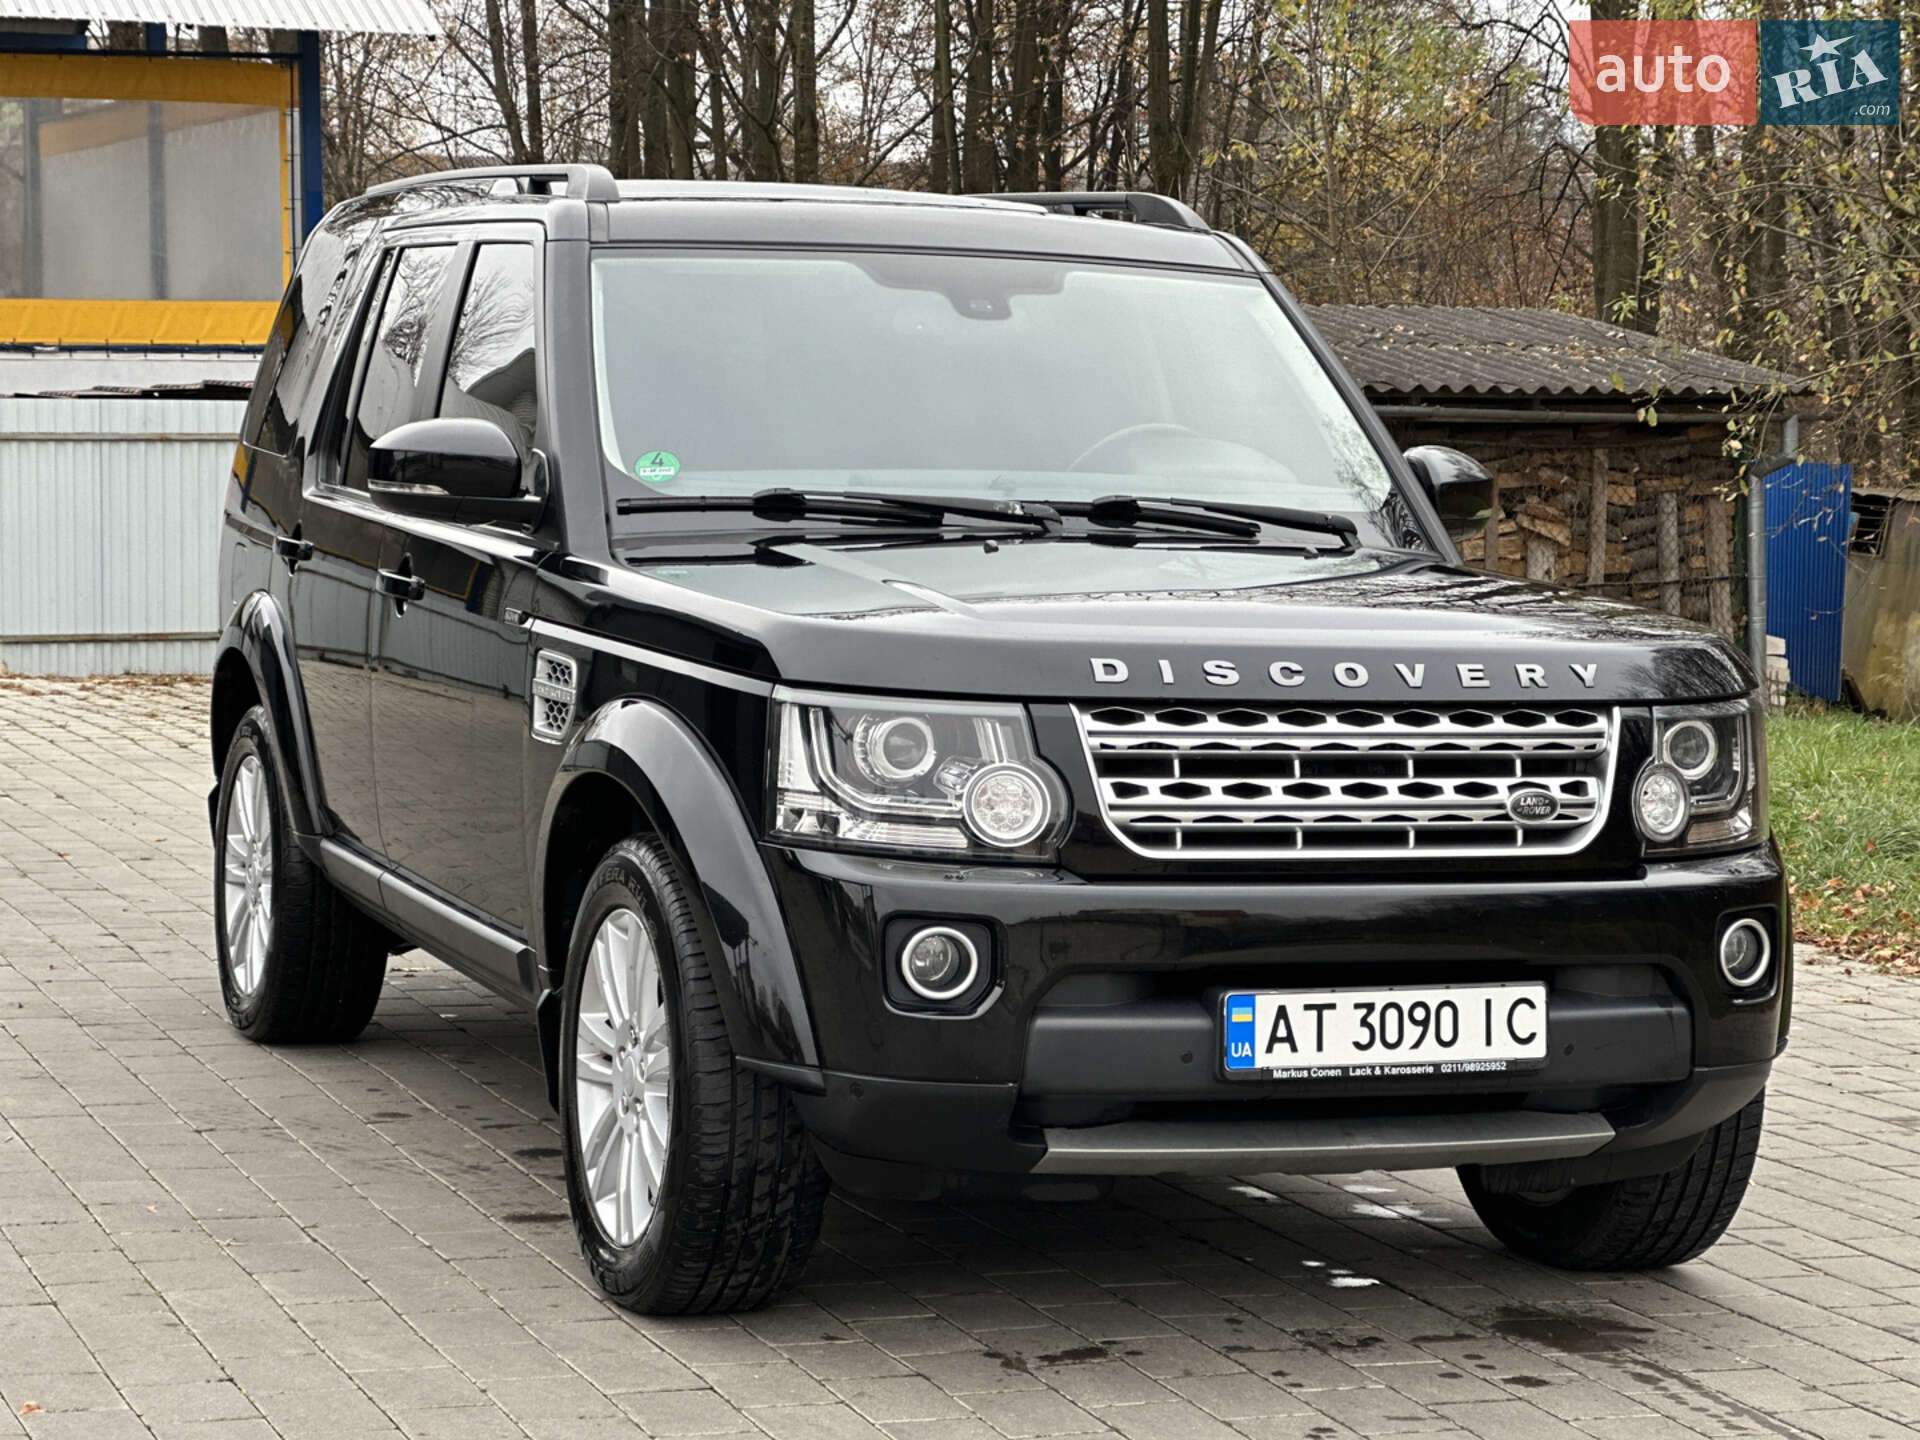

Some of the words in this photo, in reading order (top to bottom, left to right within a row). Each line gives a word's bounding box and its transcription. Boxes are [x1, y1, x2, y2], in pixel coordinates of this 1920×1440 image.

[651, 452, 664, 466] 4
[1090, 657, 1598, 688] DISCOVERY
[1520, 796, 1545, 806] LAND
[1522, 806, 1551, 815] ROVER
[1265, 1003, 1337, 1054] AT
[1352, 1000, 1459, 1051] 3090
[1484, 997, 1537, 1047] IC
[1231, 1042, 1252, 1058] UA
[1273, 1068, 1308, 1079] Markus
[1310, 1067, 1342, 1077] Conen
[1349, 1066, 1372, 1076] Lack
[1374, 1066, 1381, 1075] &
[1383, 1064, 1434, 1076] Karosserie
[1441, 1061, 1507, 1073] 0211/98925952
